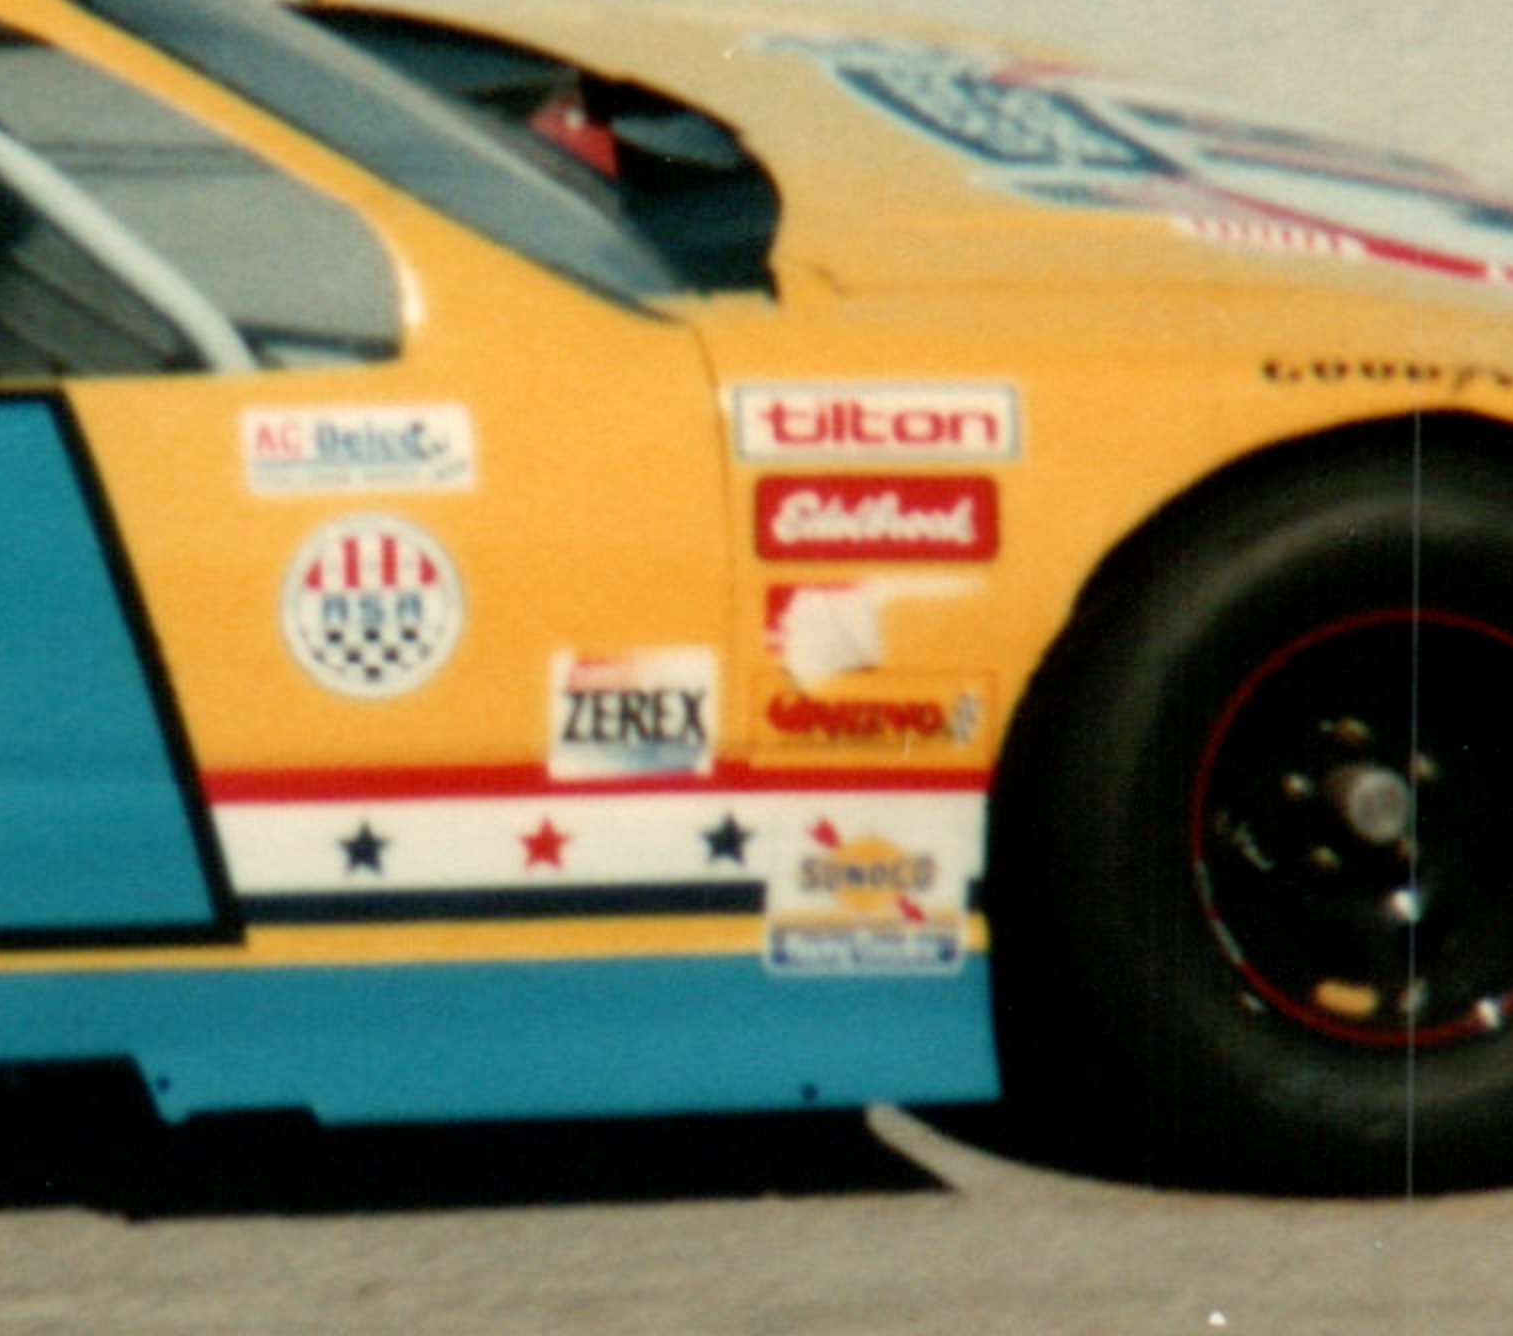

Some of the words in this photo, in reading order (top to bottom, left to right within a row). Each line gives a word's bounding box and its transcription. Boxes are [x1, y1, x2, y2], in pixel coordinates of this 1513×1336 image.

[761, 400, 1000, 447] tilton
[319, 594, 425, 625] ASA
[560, 686, 709, 750] ZEREX
